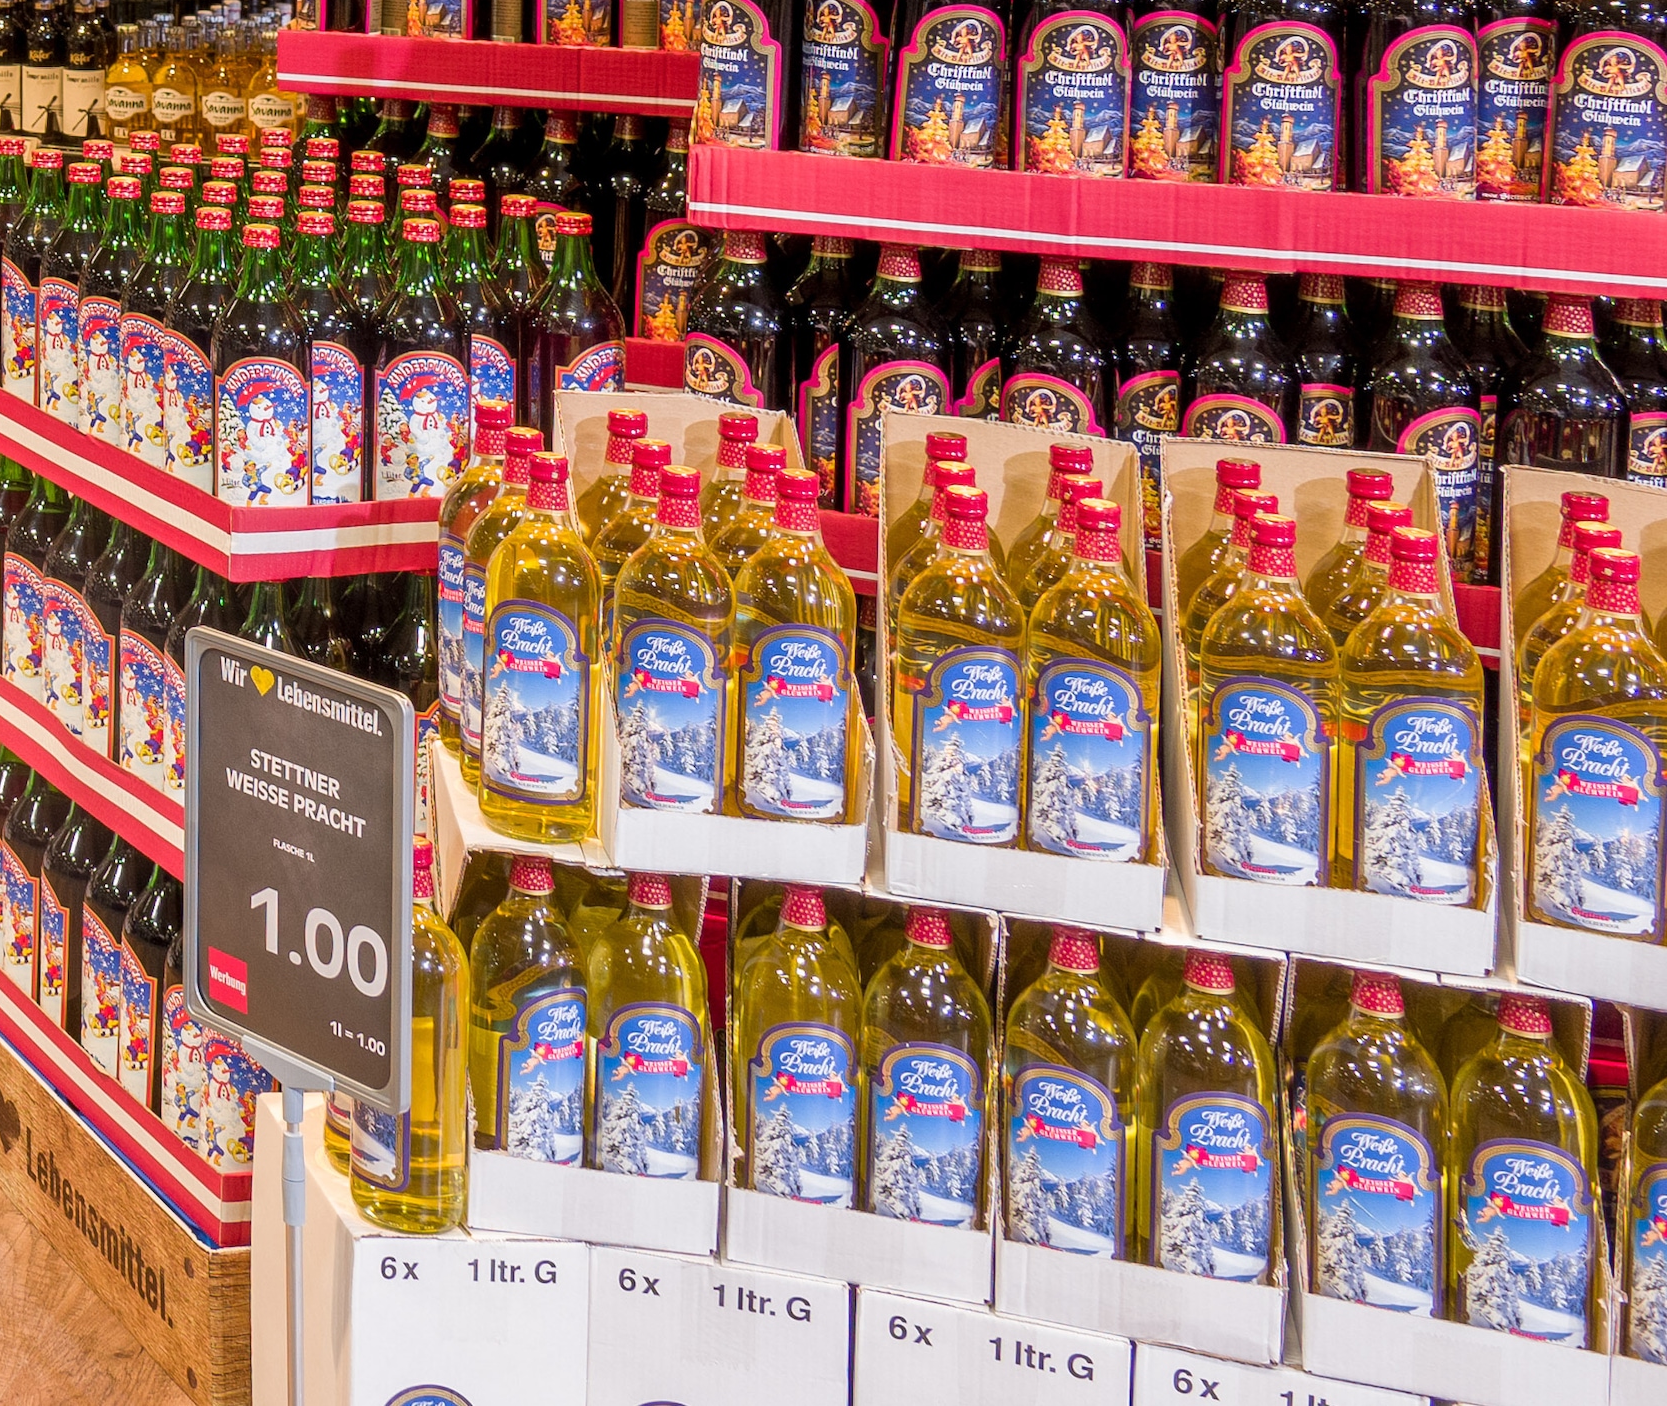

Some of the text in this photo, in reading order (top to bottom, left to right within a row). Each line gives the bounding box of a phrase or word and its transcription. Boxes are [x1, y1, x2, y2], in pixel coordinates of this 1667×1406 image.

[203, 101, 245, 118] Savanna
[228, 367, 305, 397] KINDERPUNSCH
[509, 617, 547, 637] Weiße
[501, 629, 553, 654] Pracht
[647, 637, 685, 656] Weiße
[638, 649, 691, 674] Pracht
[220, 656, 382, 736] Wir Lebensmittel.
[1396, 729, 1459, 756] Pracht
[250, 748, 340, 799] STETTNER
[226, 767, 366, 838] WEISSE PRACHT
[273, 838, 315, 863] FLASCHE 1L
[250, 887, 388, 997] 1.00
[210, 964, 246, 995] Werbung
[357, 1031, 385, 1057] 1.00
[26, 1126, 173, 1328] Lebensmittel.
[487, 1258, 527, 1284] ltr.
[534, 1259, 557, 1285] G
[736, 1286, 777, 1317] ltr.
[785, 1295, 812, 1322] G
